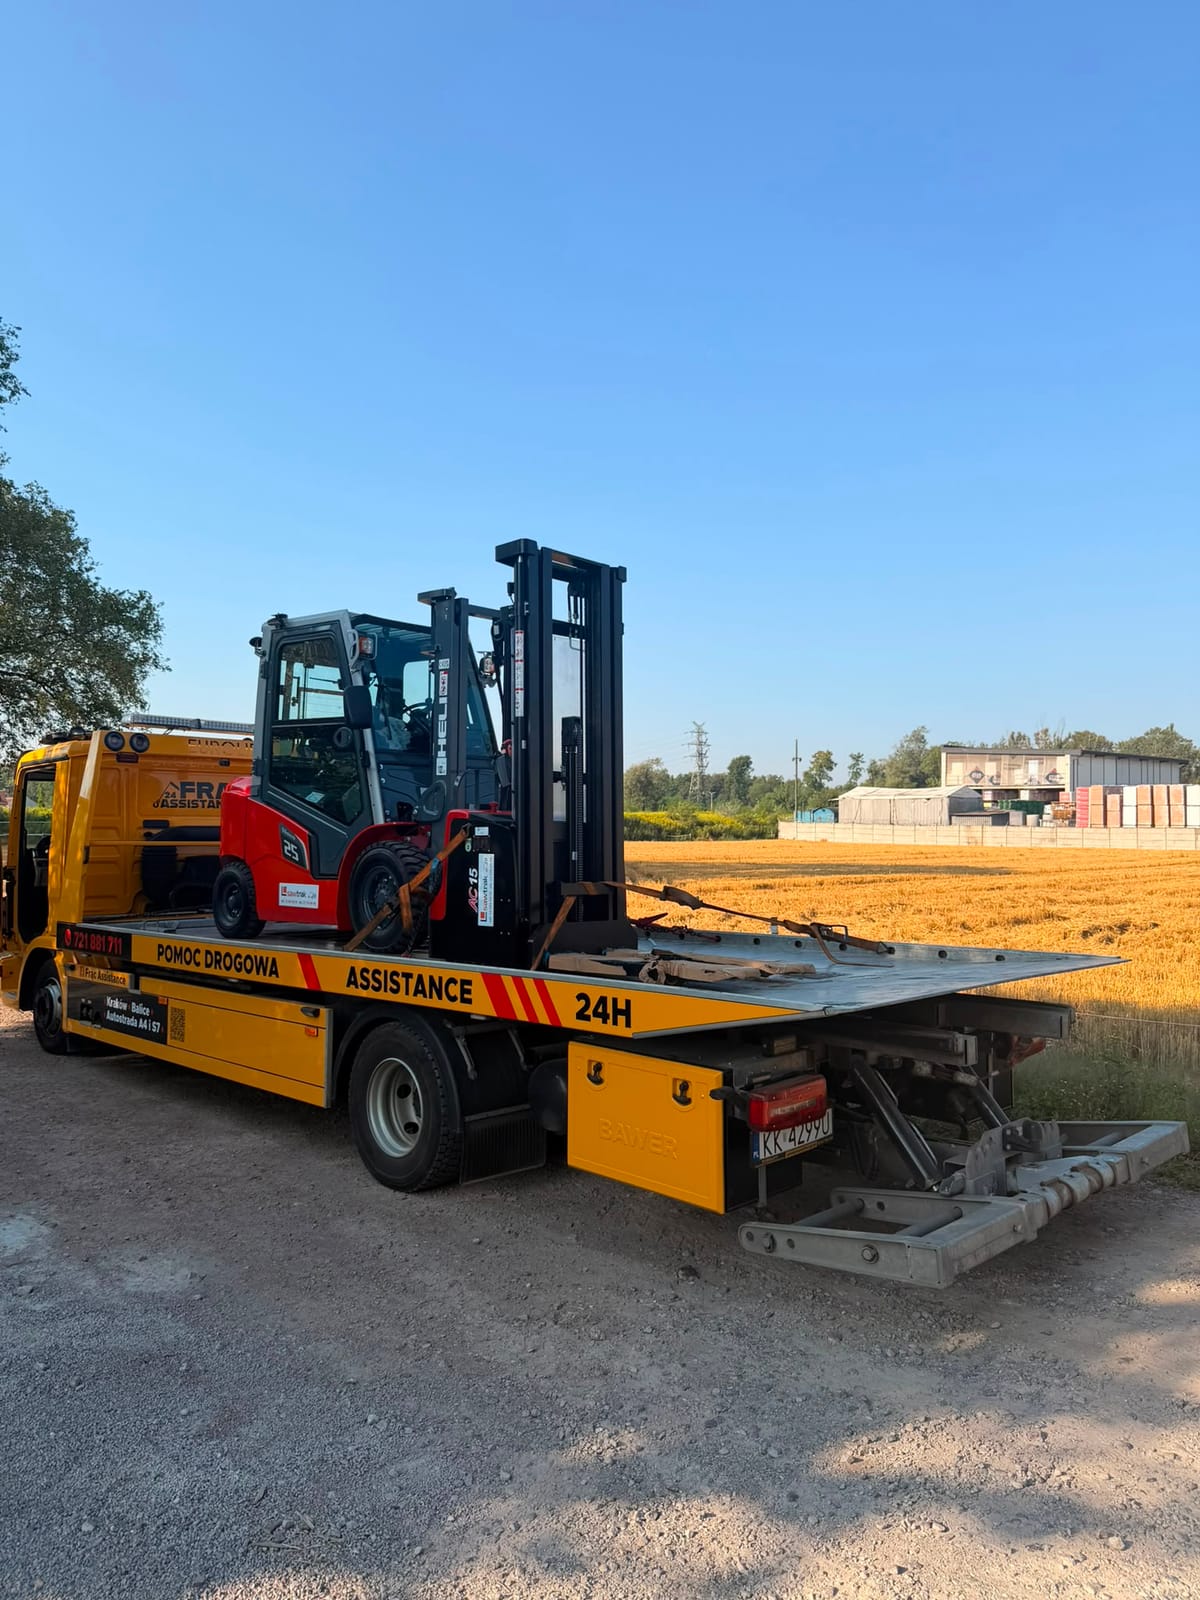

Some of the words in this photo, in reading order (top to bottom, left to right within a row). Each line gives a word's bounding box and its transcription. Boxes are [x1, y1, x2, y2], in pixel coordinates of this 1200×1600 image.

[438, 696, 448, 757] HELI
[283, 839, 299, 861] 25
[468, 867, 478, 886] 15
[468, 886, 478, 913] AC
[74, 931, 88, 950] 721
[90, 933, 106, 953] 881
[107, 935, 122, 956] 711
[157, 943, 201, 967] POMOC
[204, 949, 280, 978] DROGOWA
[98, 970, 126, 985] Assistance
[346, 965, 473, 1006] ASSISTANCE
[106, 996, 128, 1011] Kraków
[131, 1001, 150, 1017] Balice
[575, 992, 632, 1029] 24H
[106, 1010, 138, 1028] Autostrada
[138, 1018, 148, 1030] A4
[152, 1021, 161, 1033] S7
[599, 1117, 679, 1161] BAWER
[763, 1130, 783, 1158] KK
